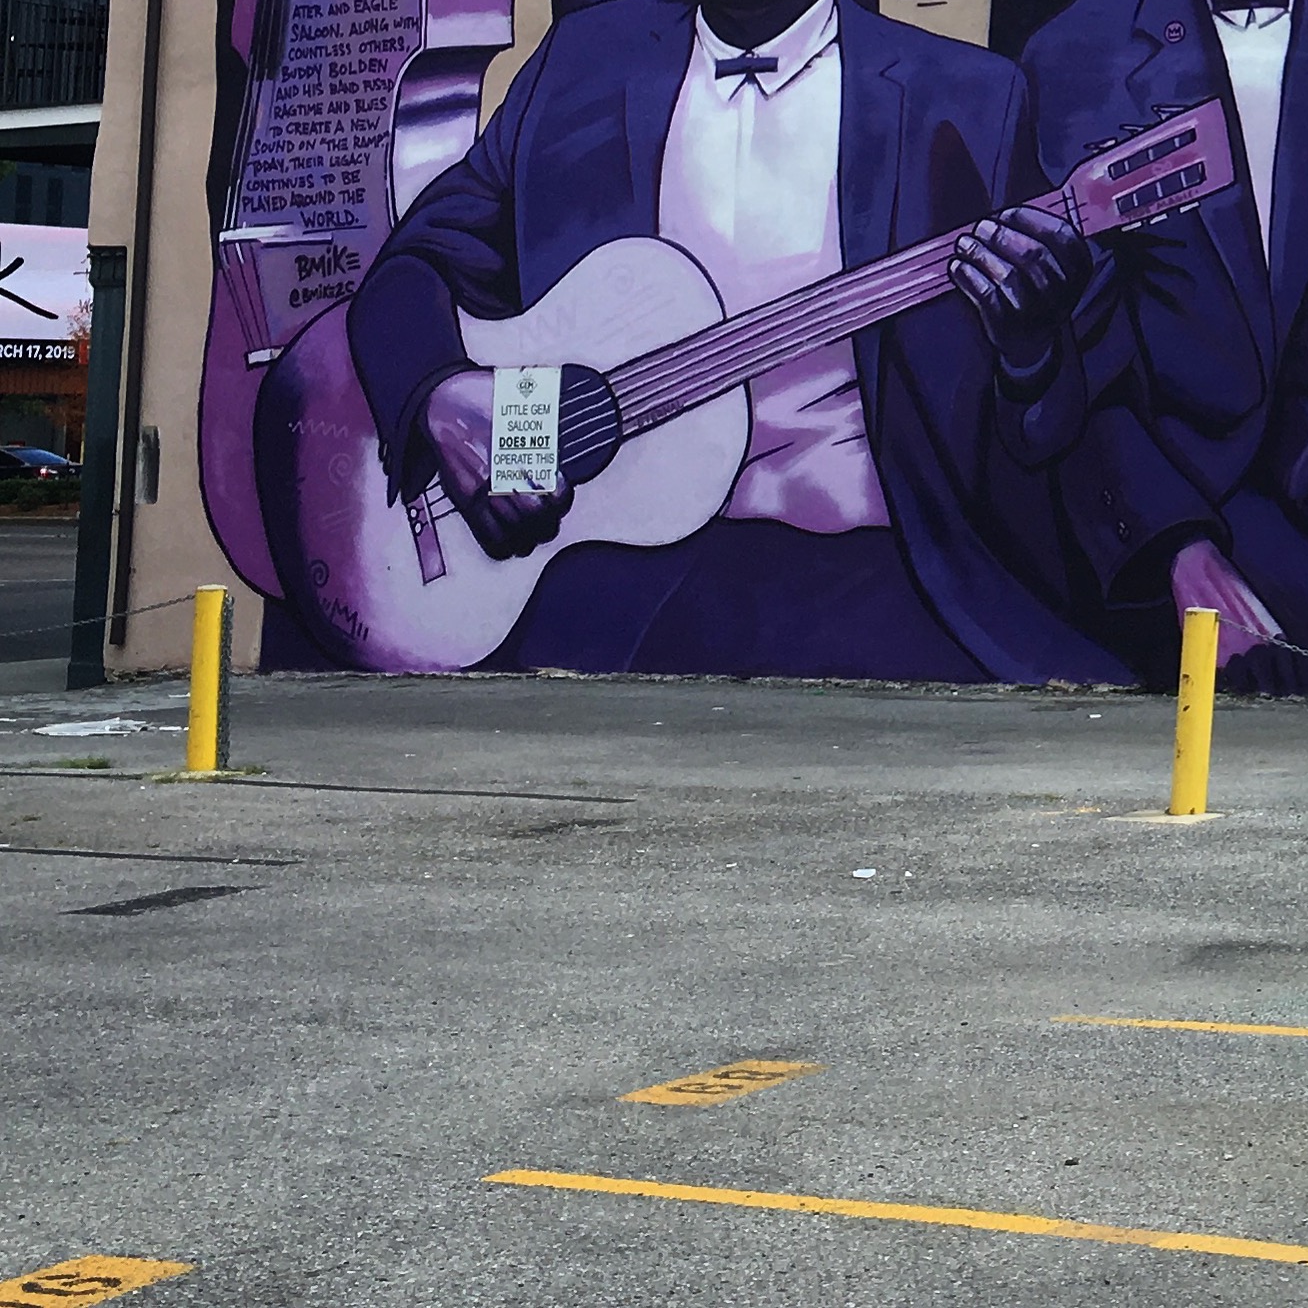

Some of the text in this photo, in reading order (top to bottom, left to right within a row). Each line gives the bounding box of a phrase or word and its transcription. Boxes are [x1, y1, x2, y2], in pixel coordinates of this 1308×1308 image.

[292, 5, 323, 19] ATER
[327, 3, 350, 16] AND
[349, 19, 389, 36] ALONG
[288, 36, 411, 62] COUNTLESS OTHERS,
[281, 59, 388, 83] BUDDY BOLDEN
[275, 79, 395, 102] AND HIS BAND FUSED
[273, 97, 388, 120] RAGTIME AND BLUES
[269, 116, 381, 138] TO CREATE A NEW
[251, 138, 295, 156] SOUND
[298, 139, 316, 152] ON
[246, 151, 370, 175] TODAY, THEIR LEGACY
[246, 169, 361, 192] CONTINUES TO BE
[241, 188, 366, 213] PLAYED AROUND THE
[300, 210, 359, 228] WORLD.
[26, 344, 43, 360] 17,
[45, 345, 75, 359] 2019
[501, 403, 551, 416] LITTLE GEM
[507, 420, 543, 432] SALOON
[499, 435, 551, 448] DOES NOT
[493, 453, 555, 465] OPERATE THIS
[496, 469, 552, 481] PARKING LOT
